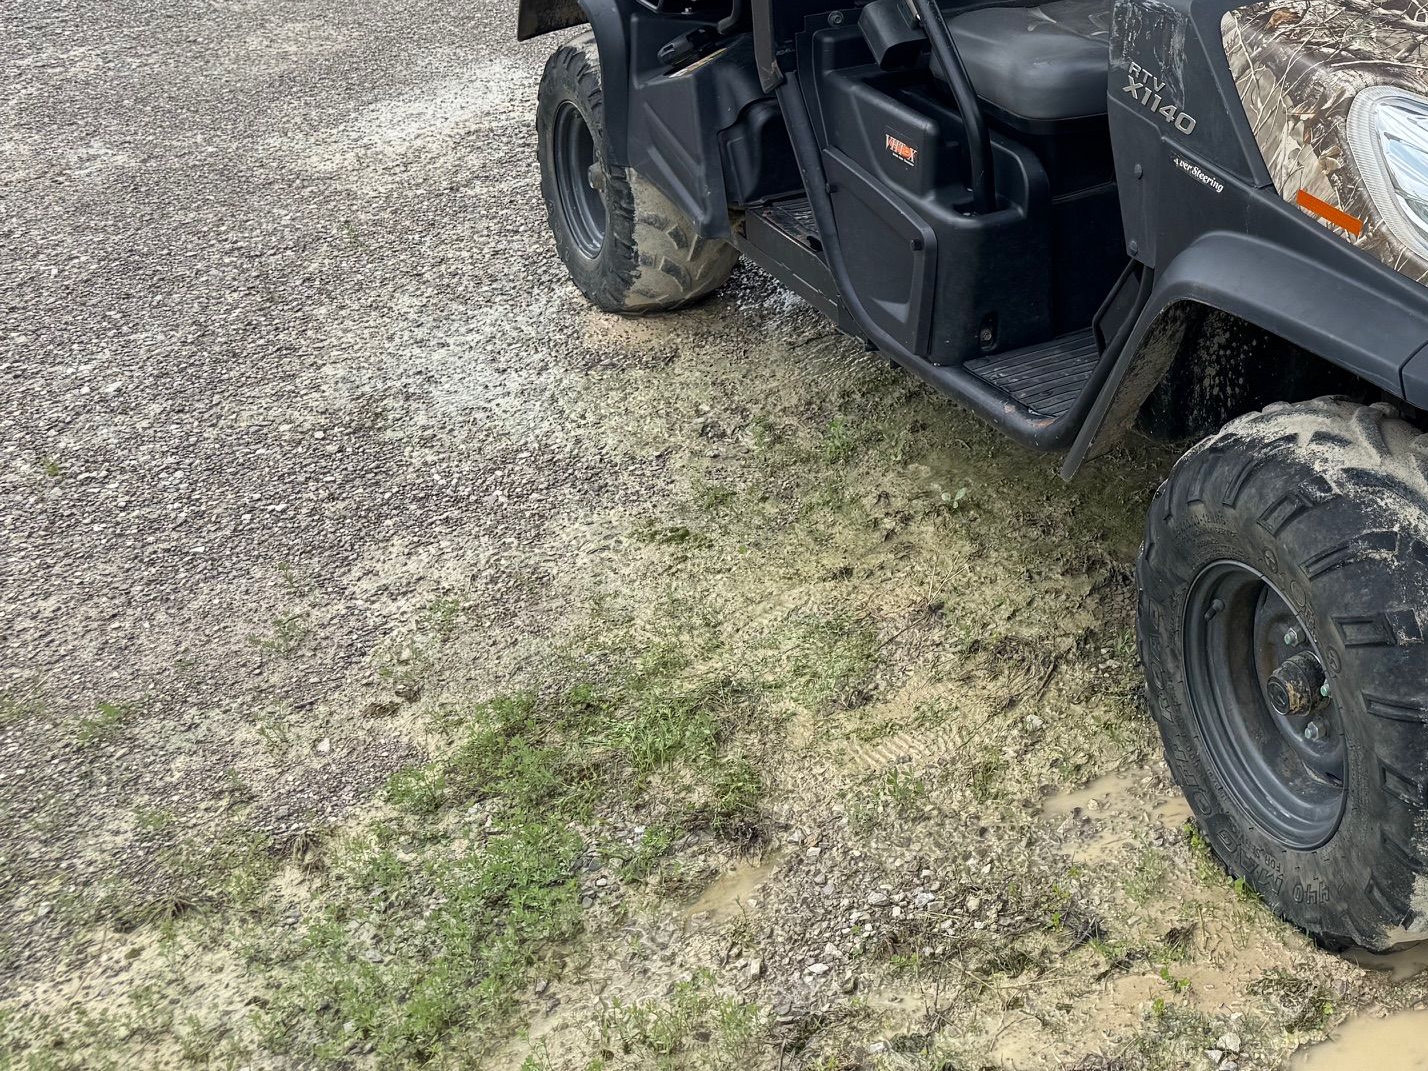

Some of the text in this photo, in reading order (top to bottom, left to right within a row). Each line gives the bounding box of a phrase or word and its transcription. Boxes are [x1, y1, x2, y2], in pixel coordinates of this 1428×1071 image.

[1129, 62, 1165, 91] RTV
[1122, 75, 1196, 134] X1140
[1192, 167, 1224, 193] Steering
[1293, 882, 1330, 905] 440
